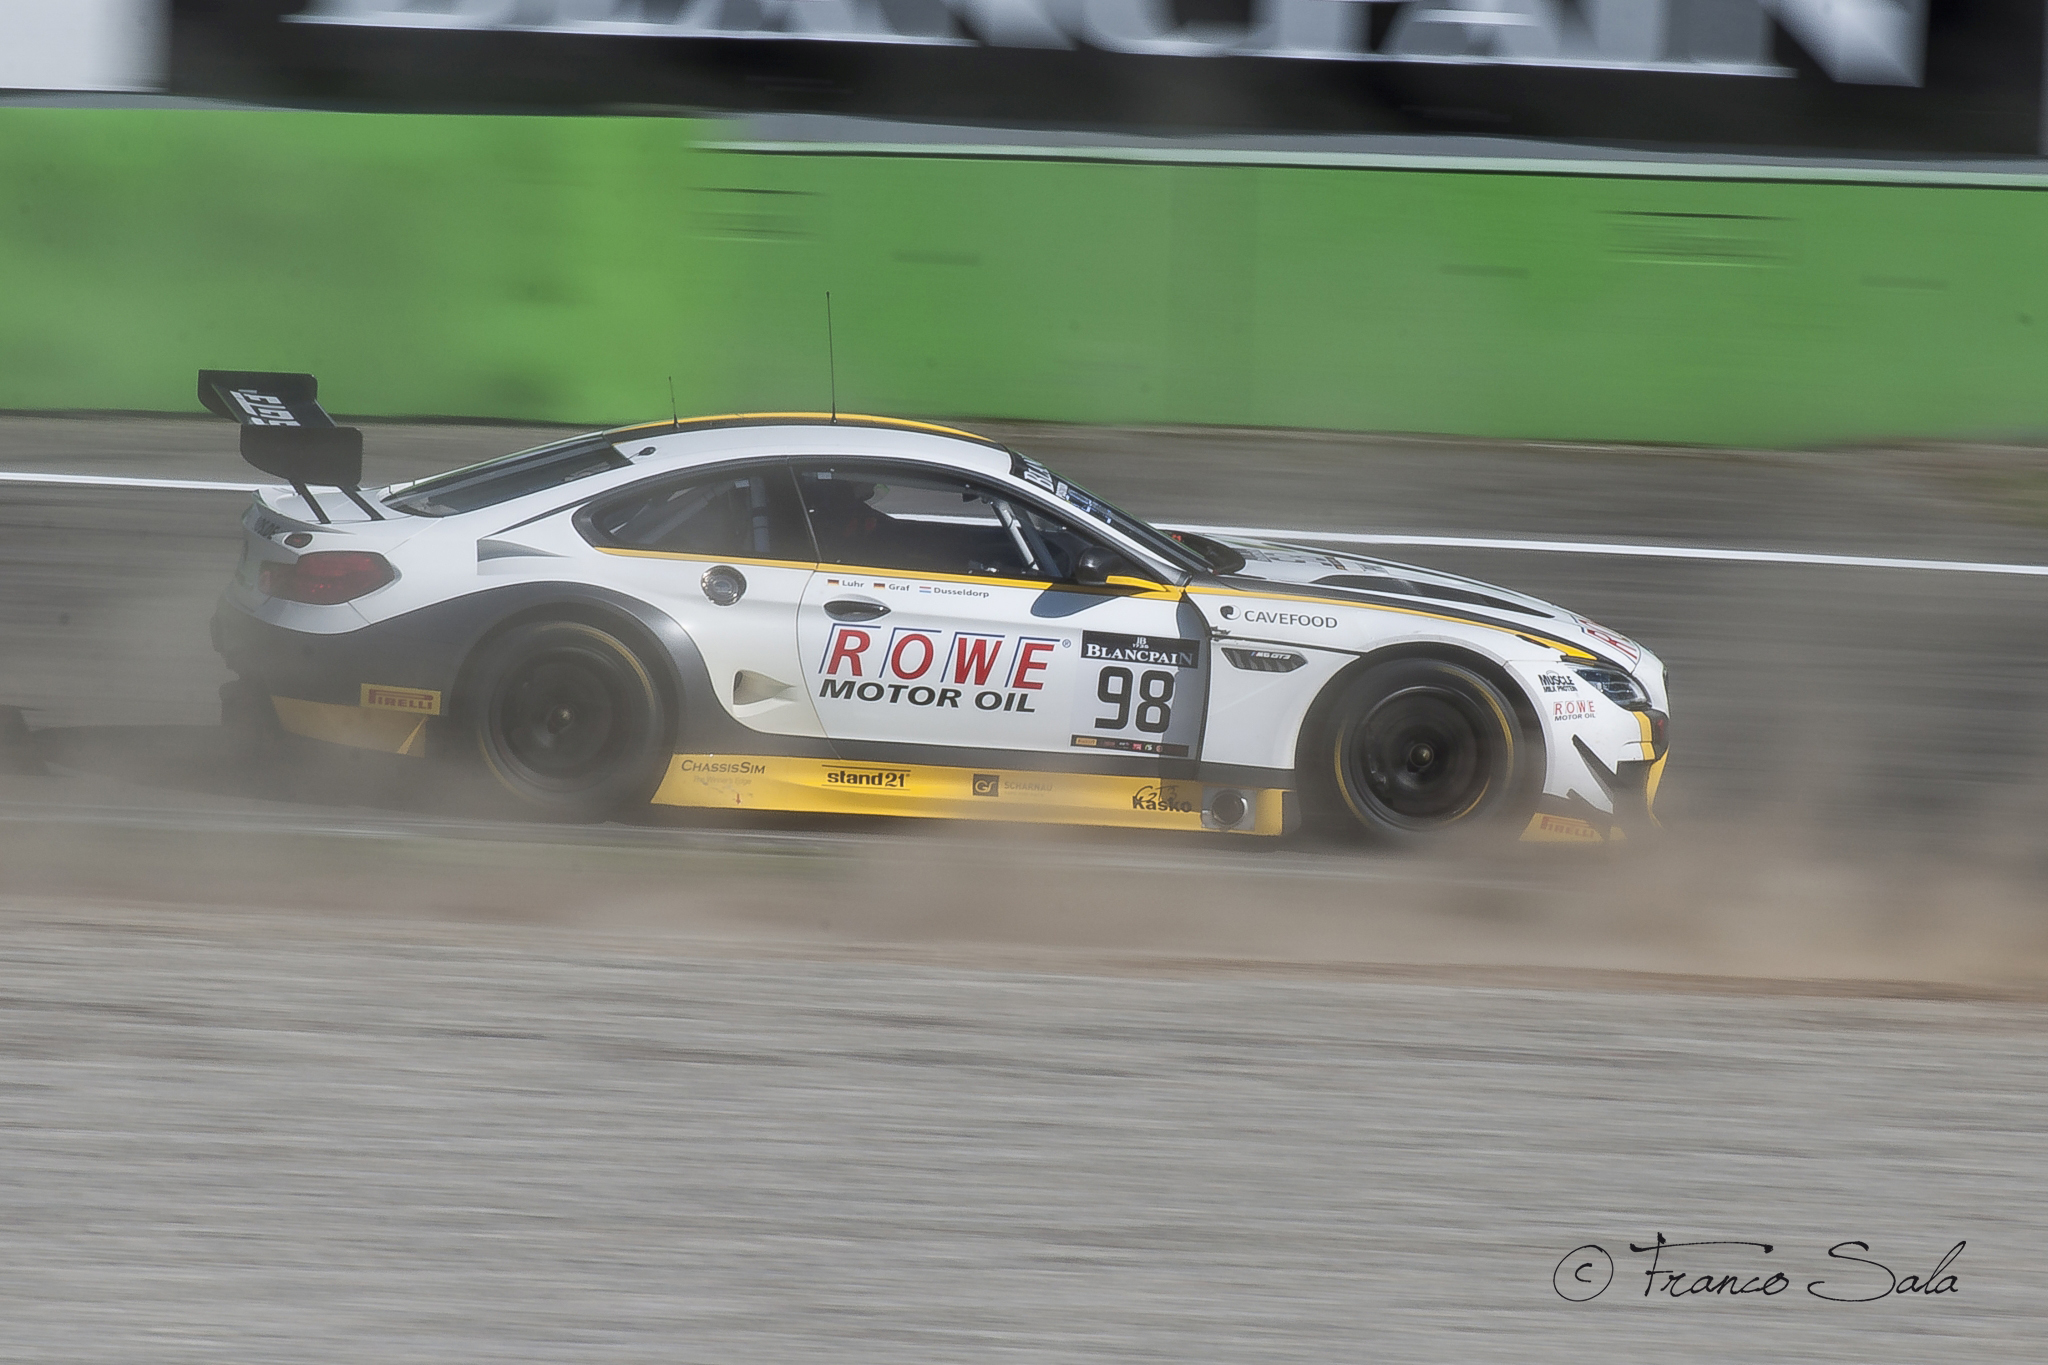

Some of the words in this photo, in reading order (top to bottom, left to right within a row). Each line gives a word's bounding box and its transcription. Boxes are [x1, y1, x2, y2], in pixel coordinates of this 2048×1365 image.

[842, 580, 865, 588] Luhr
[888, 583, 910, 591] Graf
[933, 587, 990, 598] Dusseldorp
[1244, 610, 1338, 629] CAVEFOOD
[826, 628, 1055, 690] ROWE
[1086, 643, 1192, 665] BLANCPAIN
[1538, 674, 1575, 686] MUSCLE
[368, 689, 434, 709] PIRELLI
[819, 678, 962, 709] MOTOR
[974, 690, 1036, 714] OIL
[1094, 665, 1175, 734] 98
[1554, 701, 1596, 715] ROWE
[1554, 713, 1583, 722] MOTOR
[1132, 795, 1192, 813] Kasko
